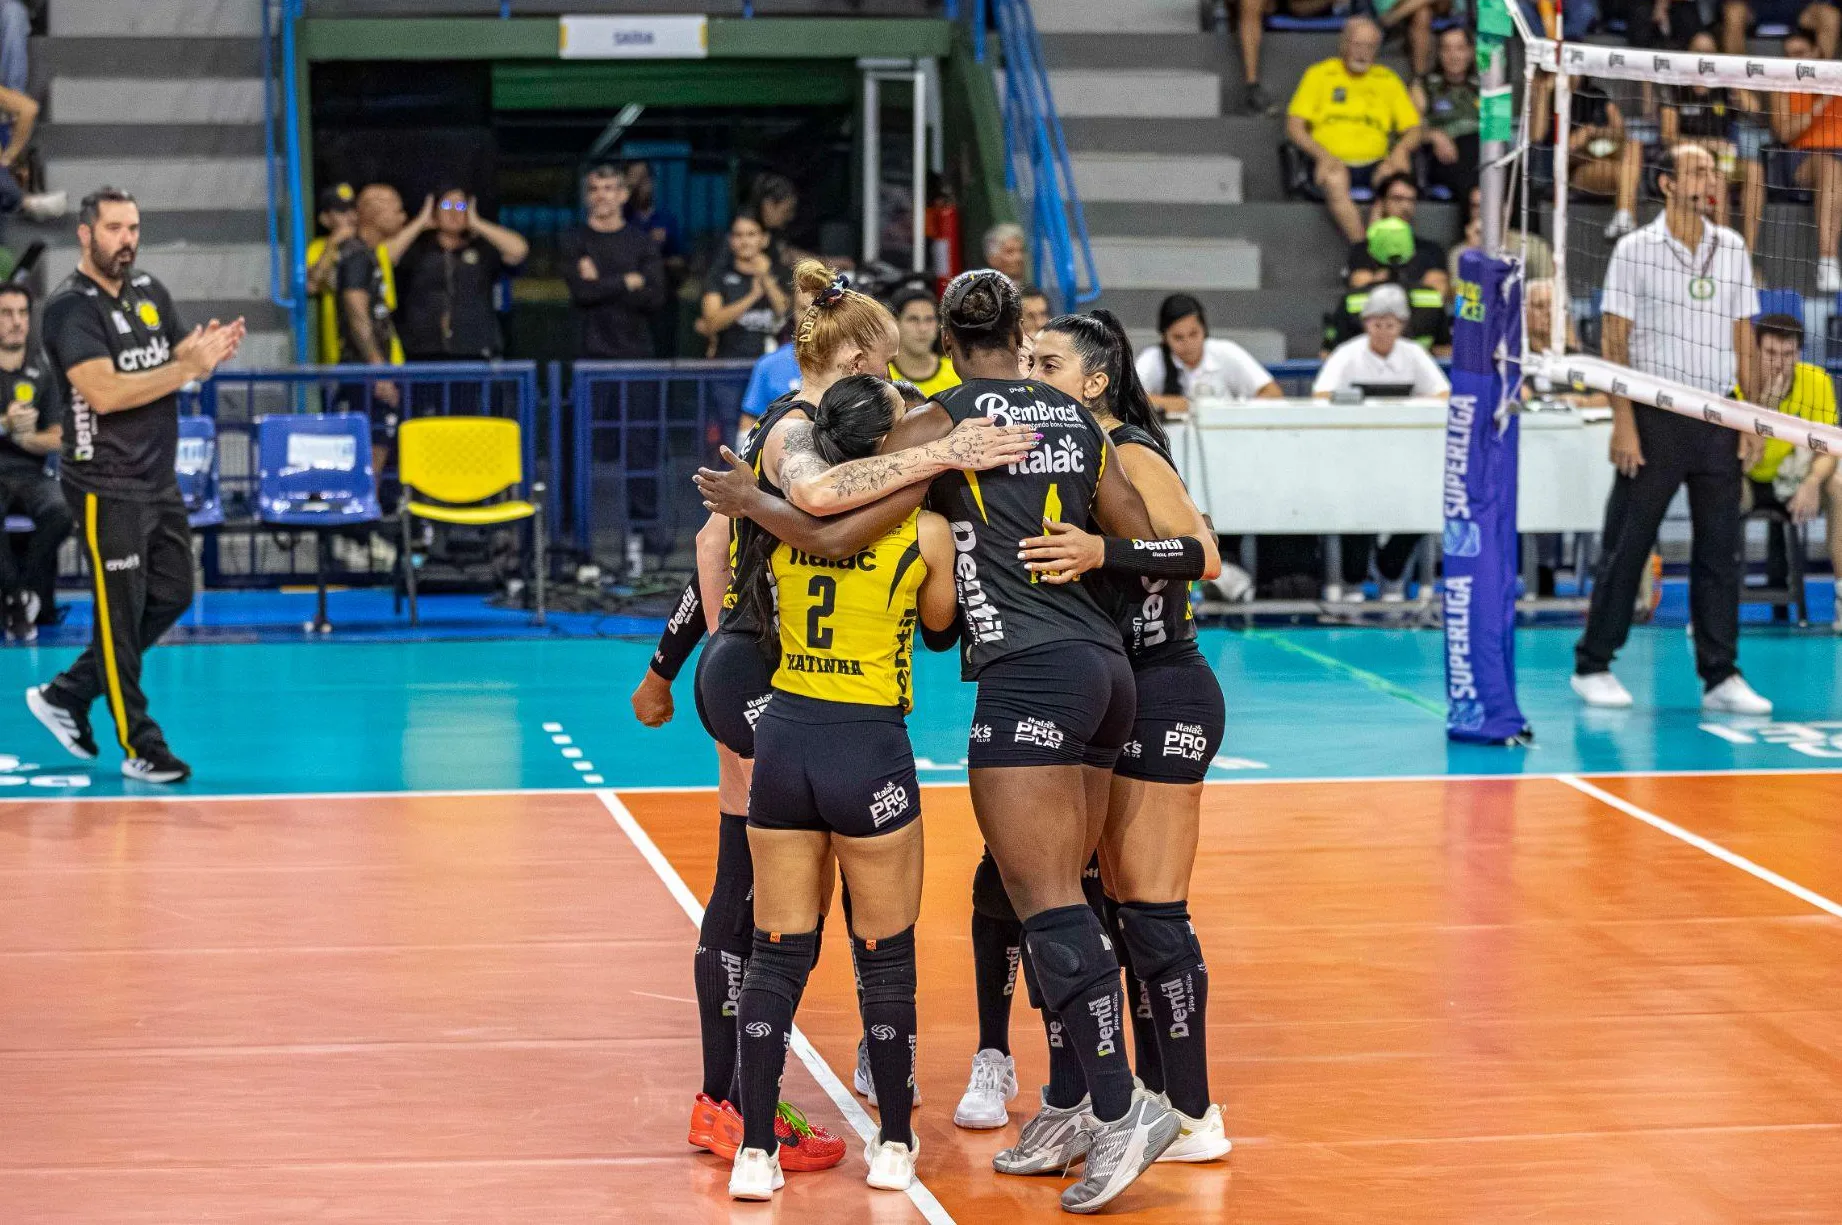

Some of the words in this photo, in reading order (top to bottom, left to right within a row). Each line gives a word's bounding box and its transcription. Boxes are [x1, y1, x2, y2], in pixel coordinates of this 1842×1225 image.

[1444, 395, 1478, 520] SUPERLIGA
[1131, 538, 1184, 551] Dentil
[950, 521, 1004, 644] Dentil
[668, 585, 695, 635] Dentil
[806, 574, 837, 650] 2
[1445, 575, 1477, 699] SUPERLIGA
[1015, 720, 1064, 743] PRO
[1164, 731, 1207, 752] PRO
[1176, 722, 1203, 736] Italac
[1162, 746, 1205, 761] PLAY
[868, 786, 906, 819] PRO
[872, 781, 896, 801] Italac
[873, 797, 909, 829] PLAY
[721, 949, 742, 1017] Dentil
[1087, 994, 1116, 1057] Dentil
[1161, 978, 1190, 1039] Dentil
